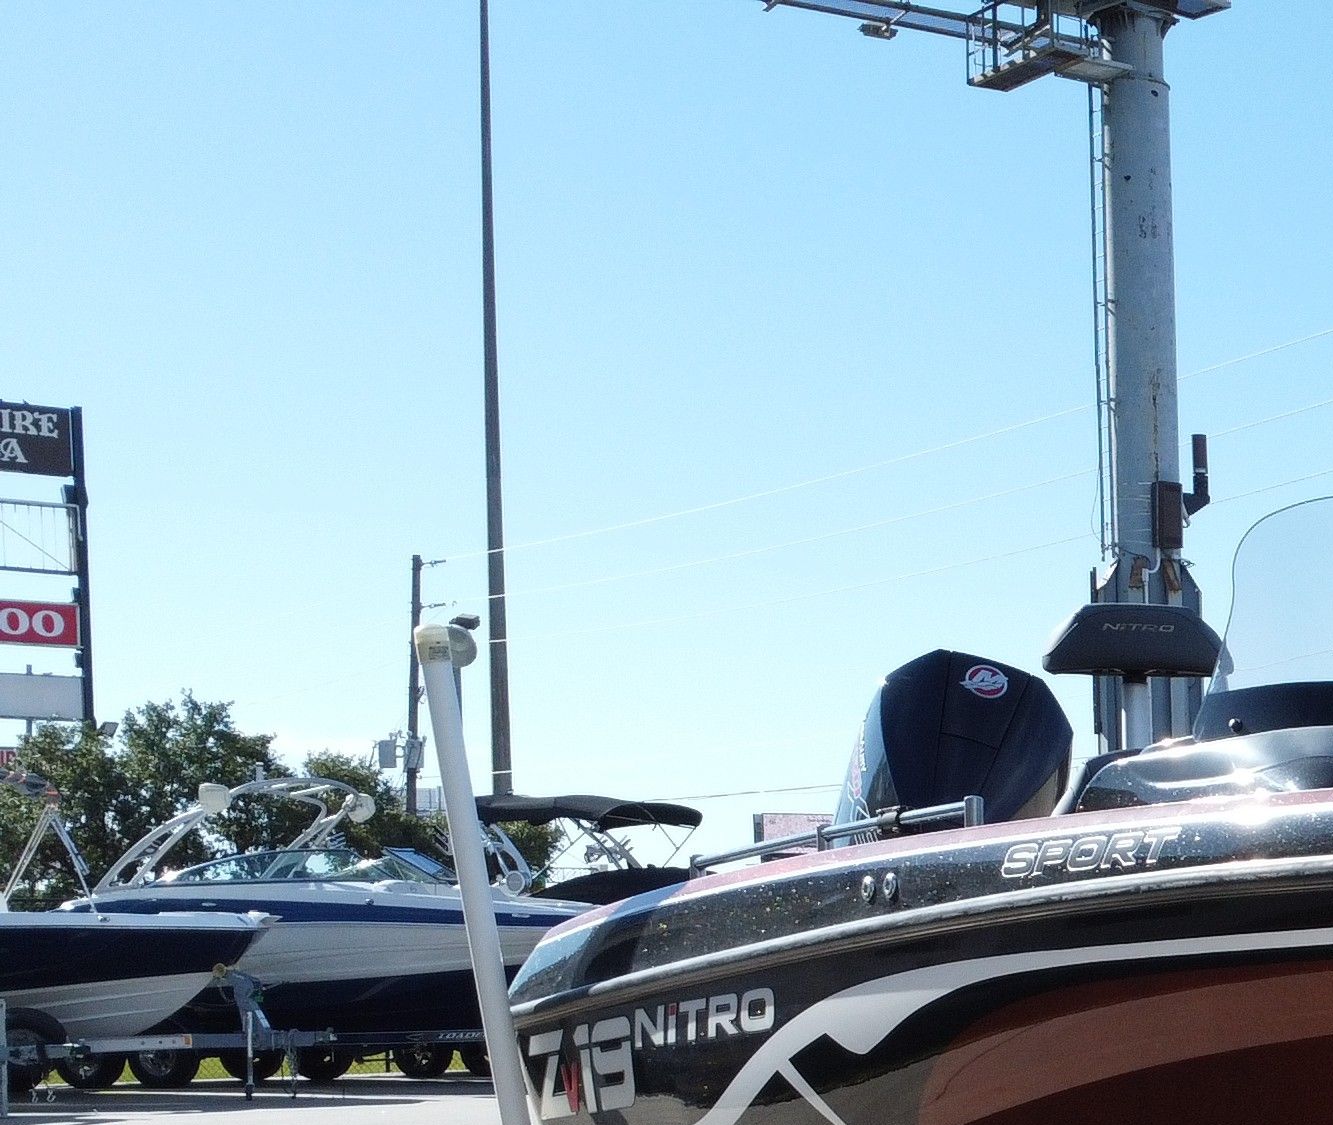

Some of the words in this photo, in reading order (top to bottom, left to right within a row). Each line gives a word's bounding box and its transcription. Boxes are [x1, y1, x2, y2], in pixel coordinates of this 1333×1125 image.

[1103, 623, 1175, 632] NITRO
[1001, 826, 1183, 878] SPORT
[635, 987, 775, 1050] NITRO
